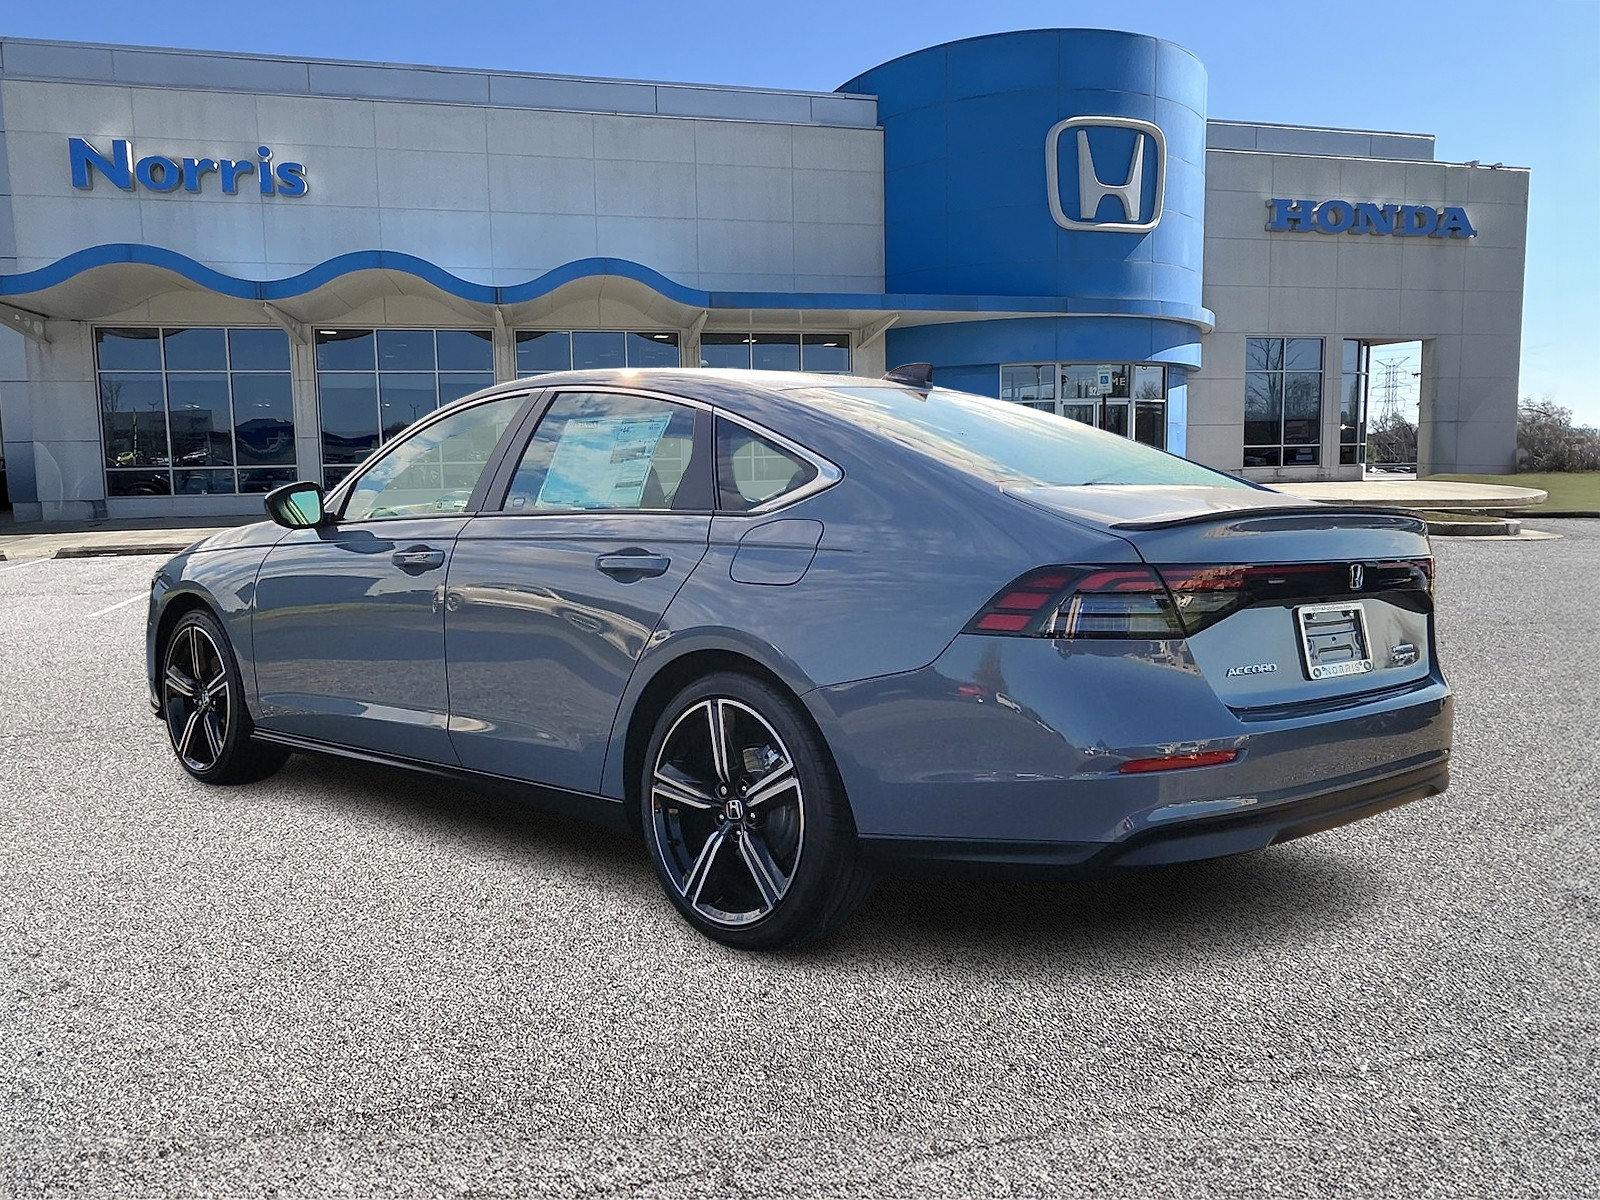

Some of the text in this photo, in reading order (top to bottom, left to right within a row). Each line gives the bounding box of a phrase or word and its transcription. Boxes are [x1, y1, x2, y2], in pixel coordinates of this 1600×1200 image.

[68, 137, 309, 198] Norris
[1265, 198, 1478, 239] HONDA
[1226, 663, 1278, 677] ACCORD
[1326, 662, 1361, 676] NORRIS
